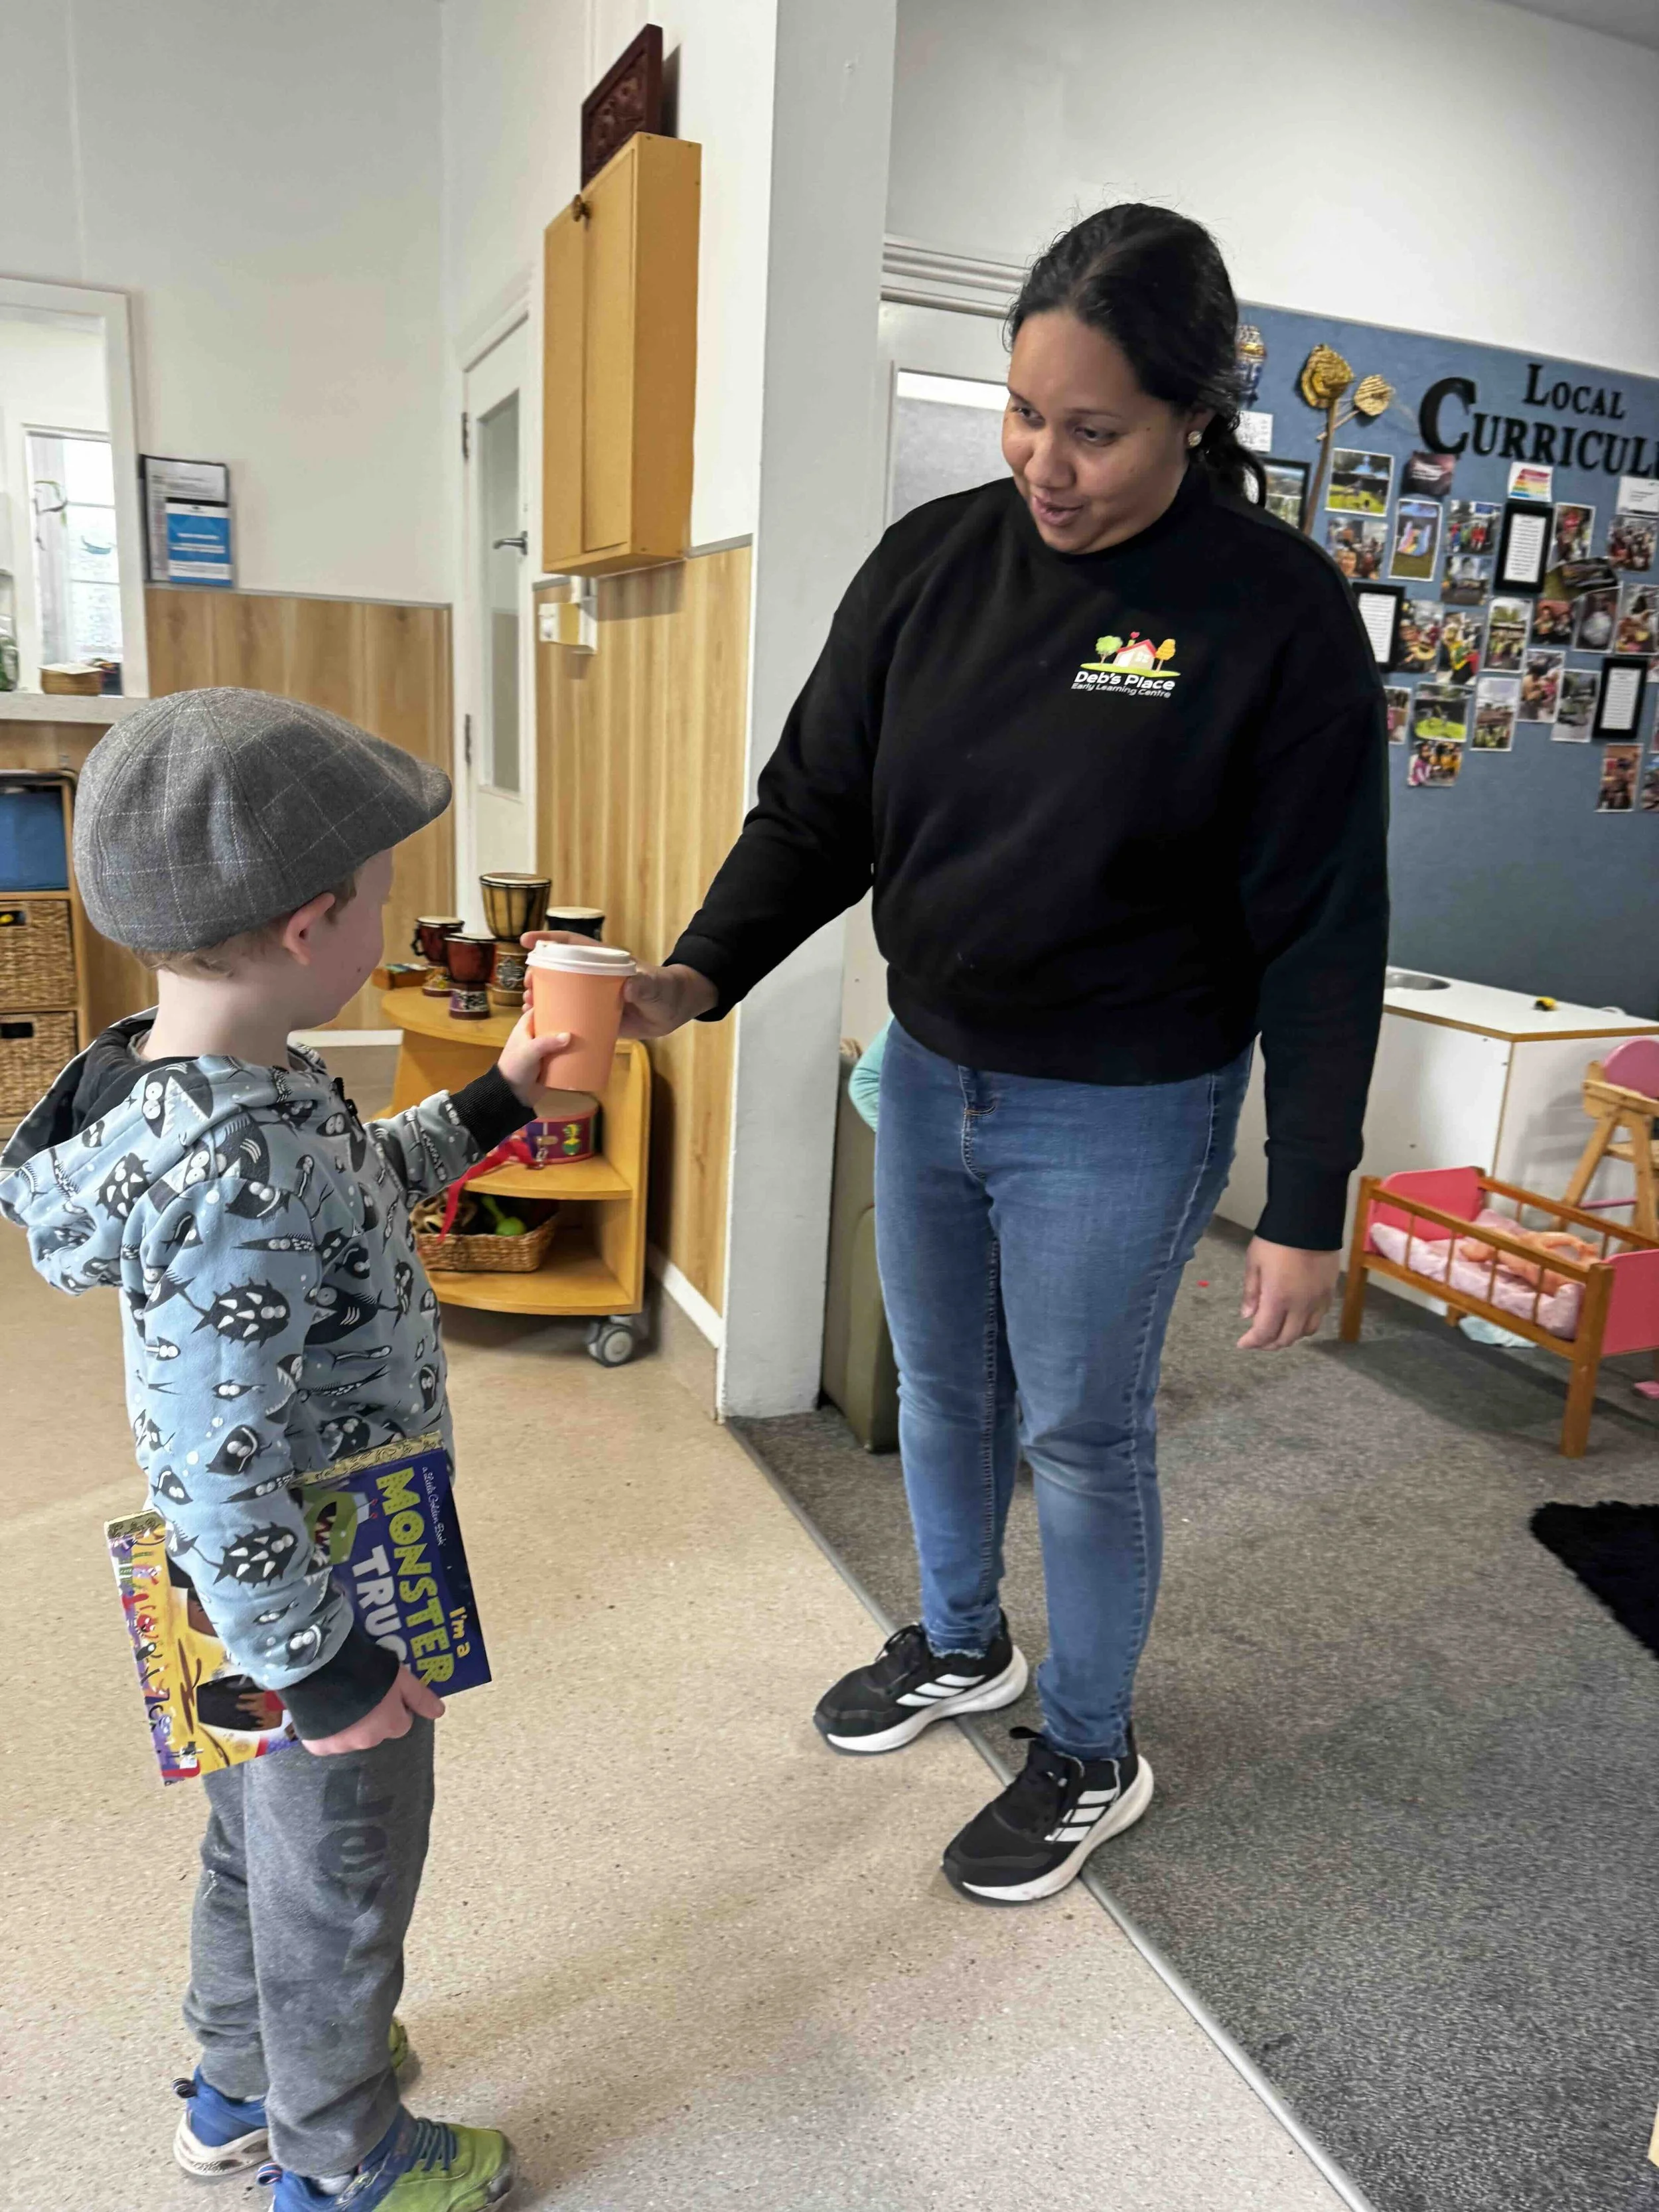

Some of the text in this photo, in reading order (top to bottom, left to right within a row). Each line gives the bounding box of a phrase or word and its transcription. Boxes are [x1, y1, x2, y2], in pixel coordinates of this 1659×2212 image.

[1523, 364, 1626, 419] LOCAL
[1418, 377, 1659, 480] CURRICUL
[1070, 682, 1171, 698] Early Learning Centre
[1074, 671, 1176, 691] Deb's Place
[427, 1493, 440, 1524] Golden
[376, 1466, 455, 1687] MONSTER
[352, 1544, 411, 1674] TRUC
[449, 1606, 471, 1659] I'm a
